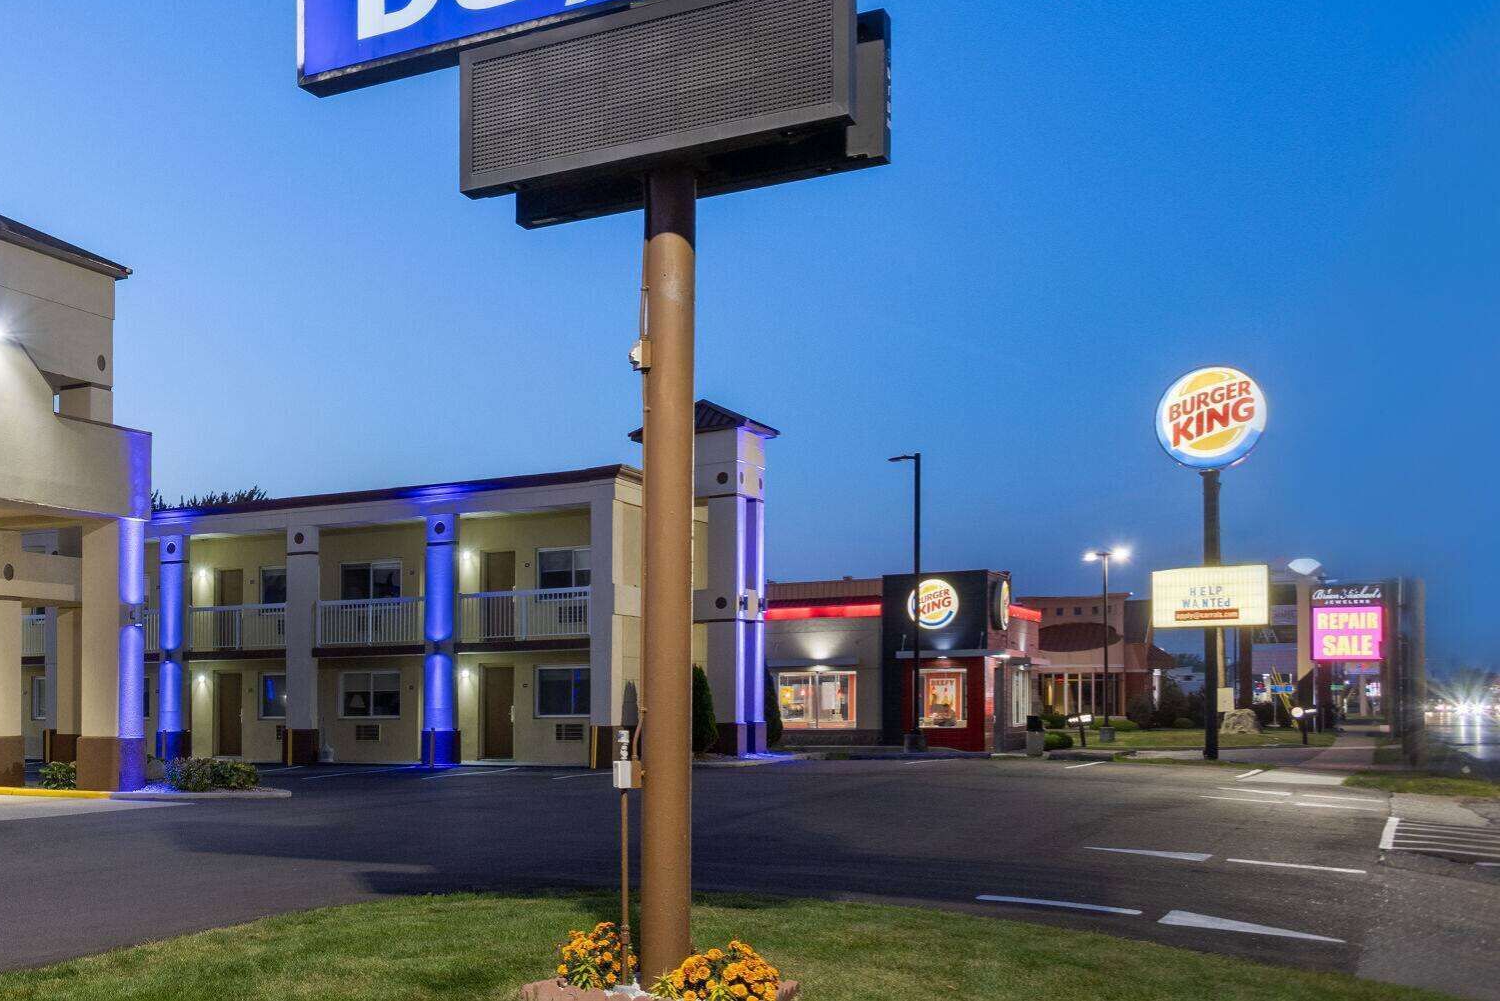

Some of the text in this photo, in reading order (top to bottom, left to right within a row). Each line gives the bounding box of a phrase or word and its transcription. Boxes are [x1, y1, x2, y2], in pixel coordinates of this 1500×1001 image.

[1169, 380, 1252, 421] BURGER
[1172, 396, 1255, 447] KING
[1189, 585, 1223, 596] HELP
[1317, 612, 1378, 630] REPAIR
[1322, 634, 1374, 656] SALE
